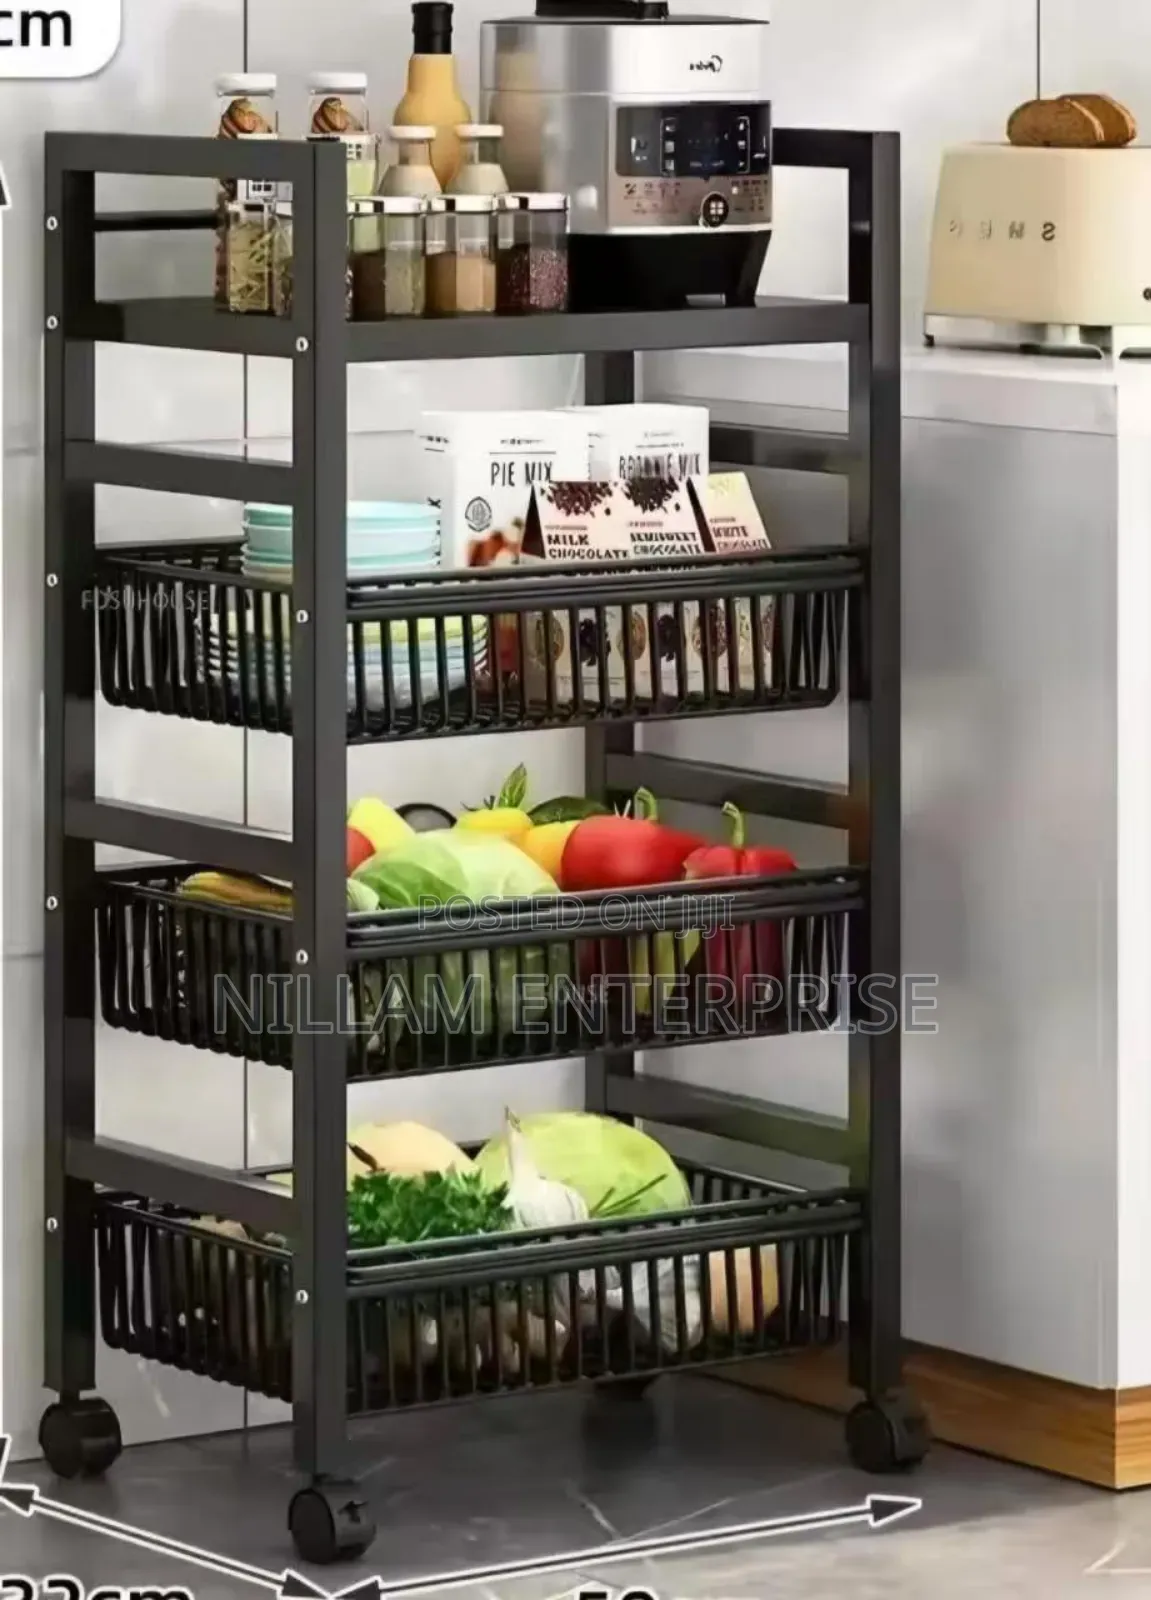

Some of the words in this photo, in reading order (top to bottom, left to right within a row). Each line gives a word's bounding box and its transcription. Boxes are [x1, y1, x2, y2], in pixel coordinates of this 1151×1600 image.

[491, 461, 515, 487] PIE
[547, 534, 590, 546] MILK
[548, 548, 630, 560] CHOCOLATE
